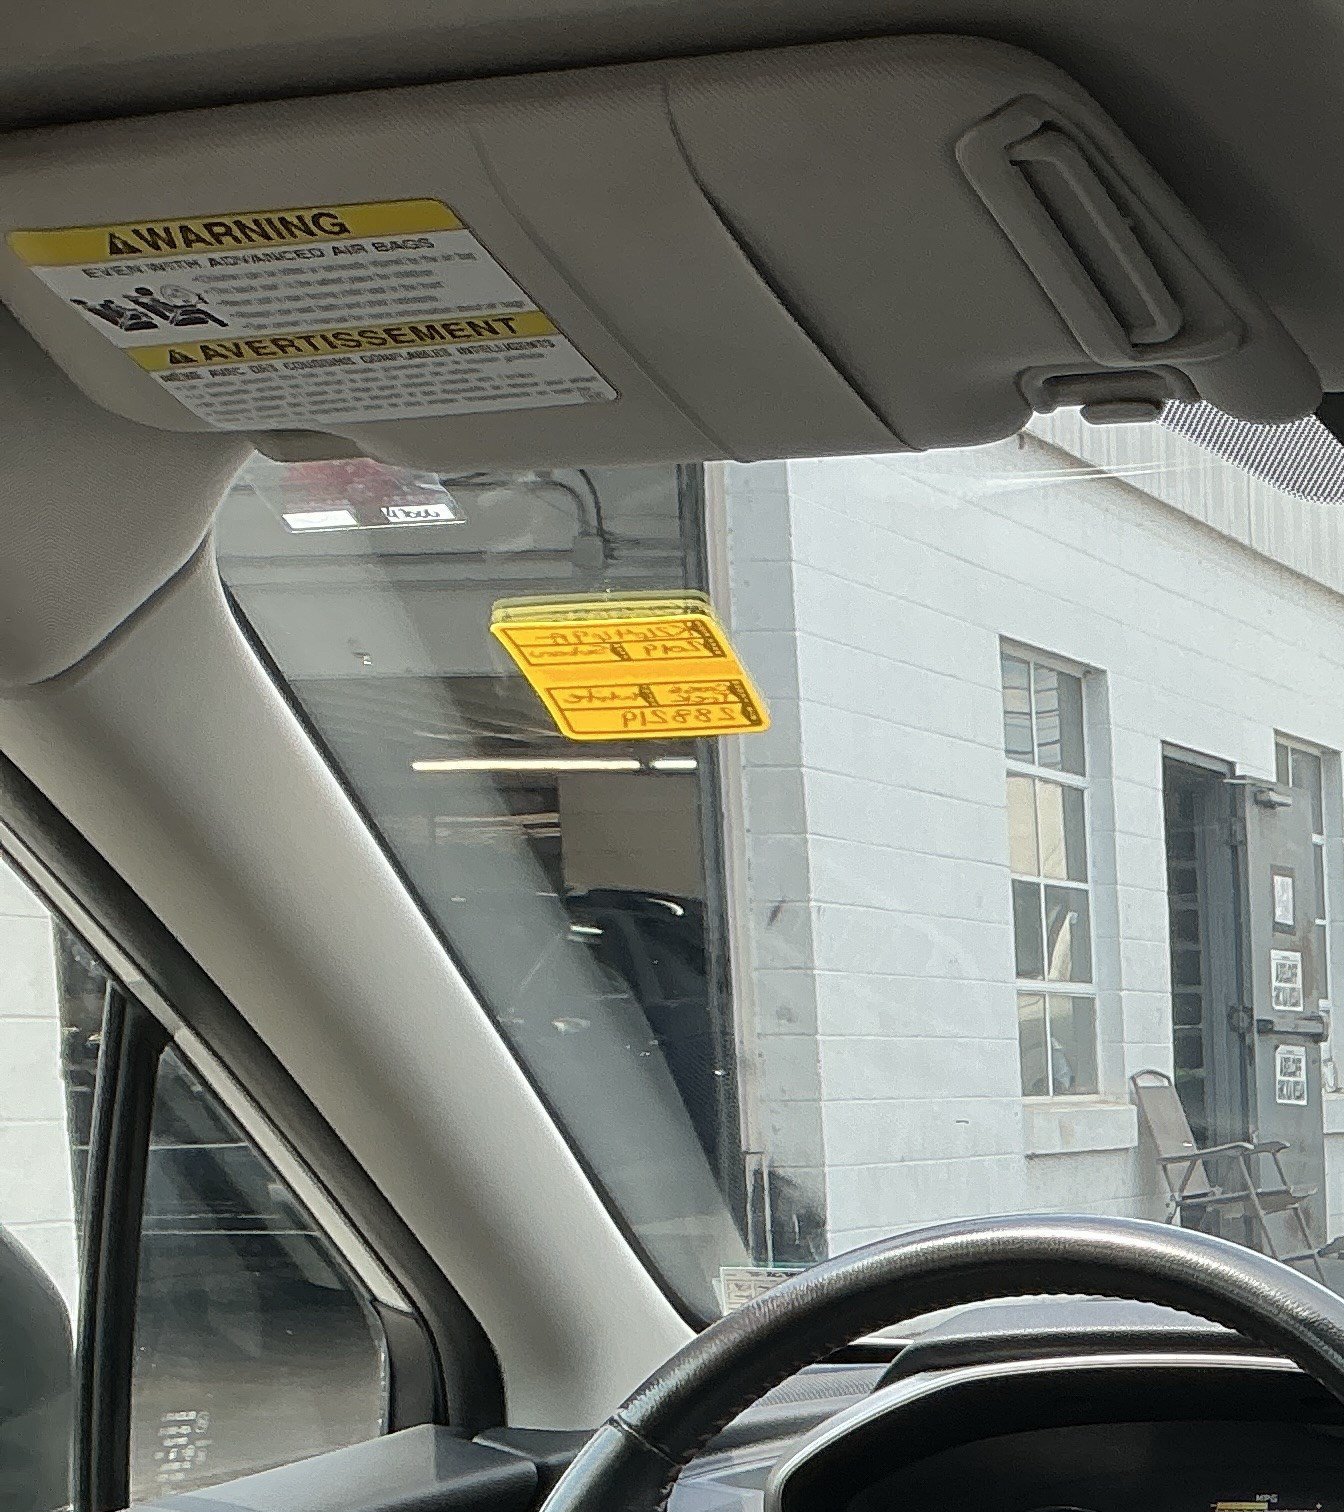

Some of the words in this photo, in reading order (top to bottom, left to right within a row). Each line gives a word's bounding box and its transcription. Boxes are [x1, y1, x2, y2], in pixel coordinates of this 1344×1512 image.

[132, 212, 350, 251] WARNING
[82, 263, 144, 279] EVEN
[146, 259, 199, 274] WITH
[208, 248, 326, 269] ADVANCED
[332, 244, 367, 257] AIR
[372, 237, 434, 252] BAGS
[201, 317, 519, 362] AVERTISSEMENT
[1256, 1494, 1279, 1503] MPG
